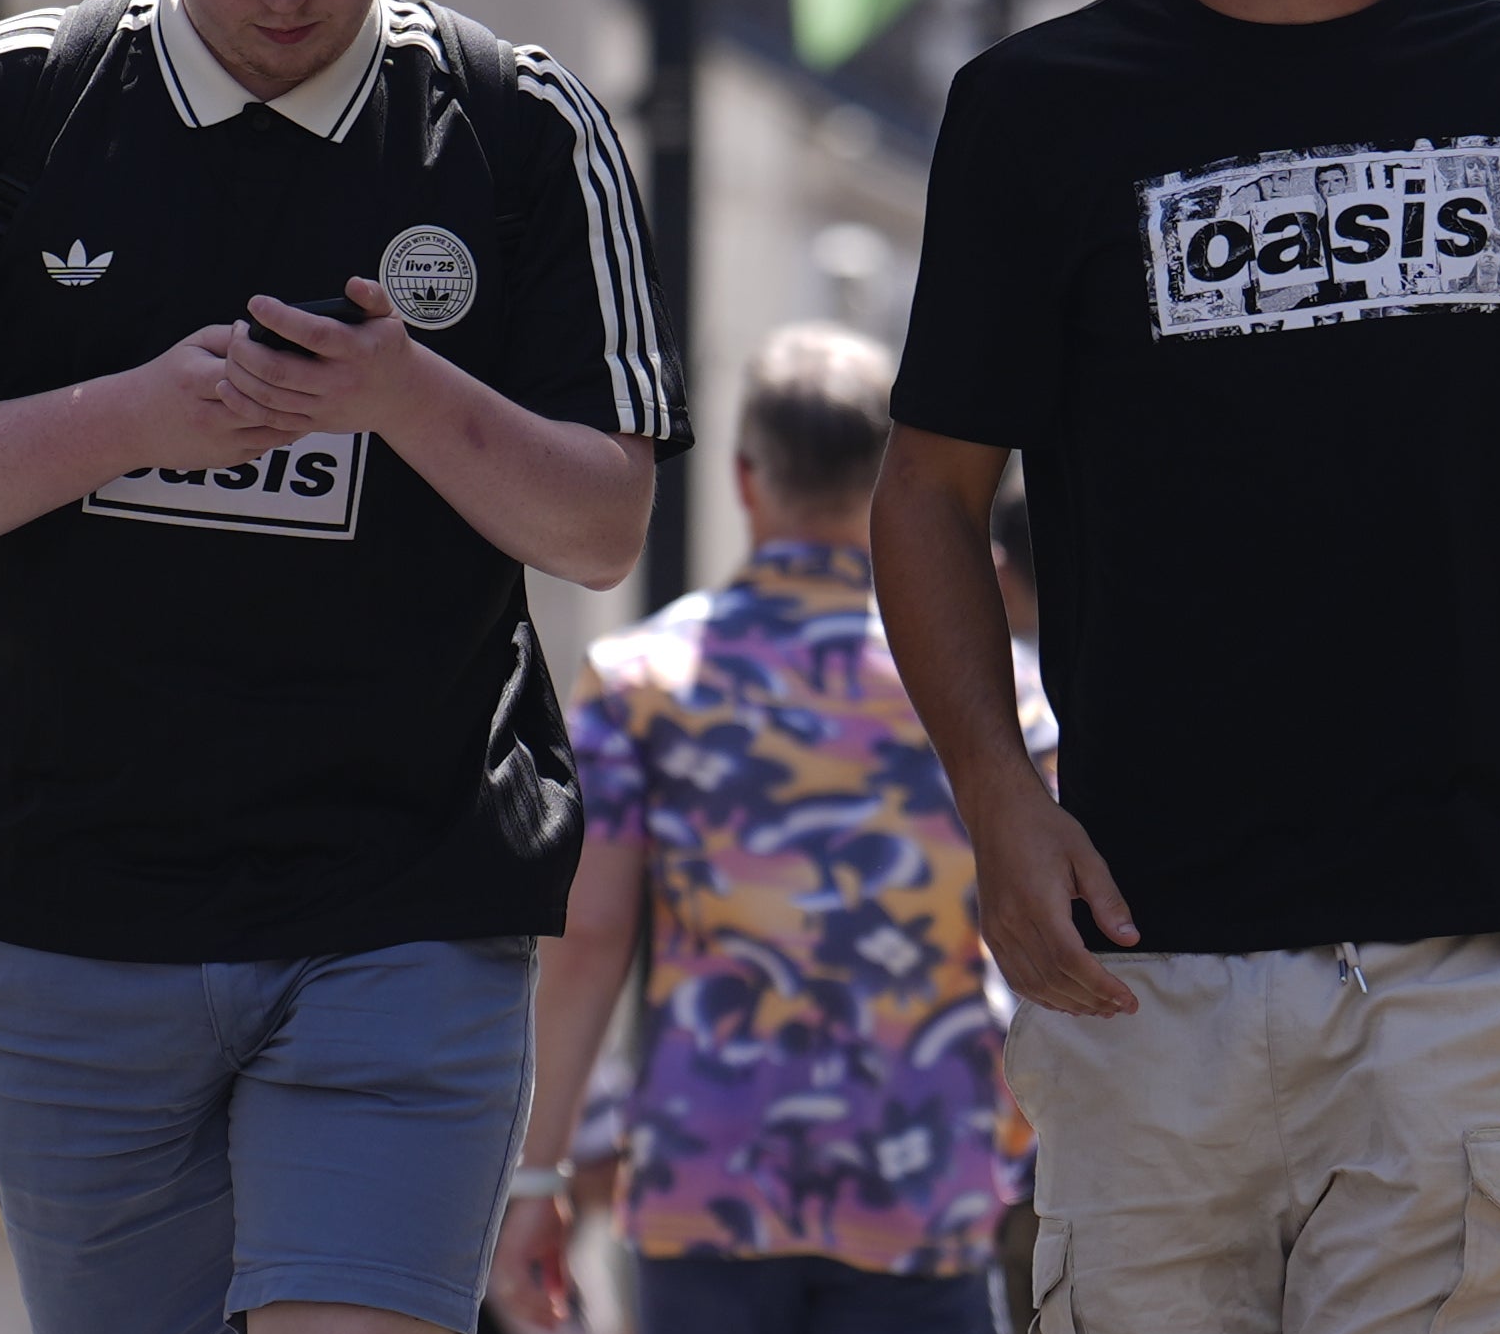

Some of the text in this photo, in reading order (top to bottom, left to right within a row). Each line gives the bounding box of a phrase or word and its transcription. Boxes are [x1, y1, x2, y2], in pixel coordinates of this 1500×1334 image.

[1185, 178, 1489, 284] oasis
[389, 259, 399, 273] THE
[395, 241, 412, 258] BAND
[411, 235, 431, 244] WITH
[432, 235, 447, 245] THE
[450, 246, 469, 275] STRIPES
[405, 260, 432, 272] live
[119, 443, 338, 497] sis
